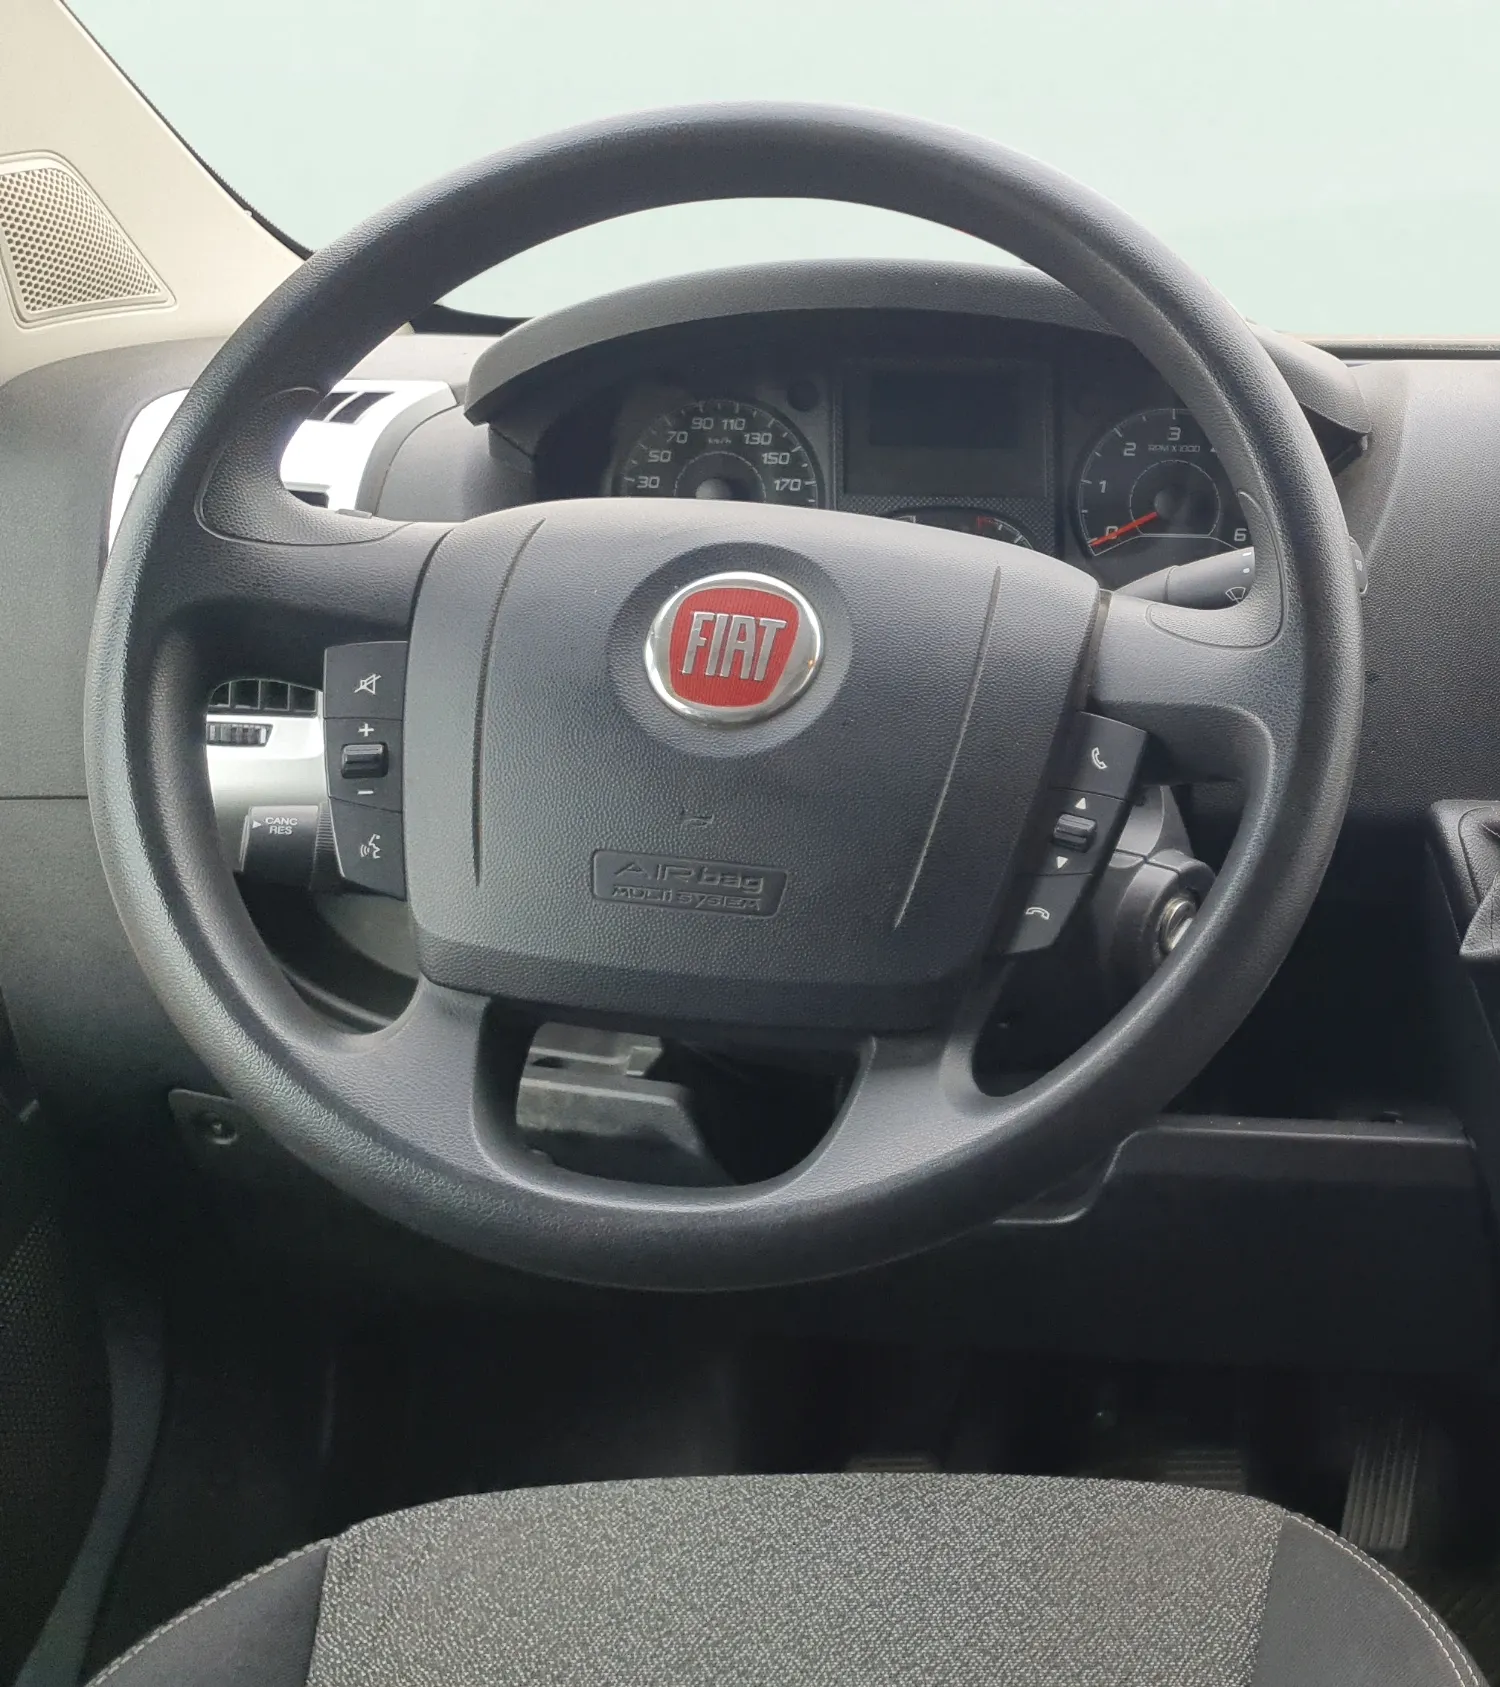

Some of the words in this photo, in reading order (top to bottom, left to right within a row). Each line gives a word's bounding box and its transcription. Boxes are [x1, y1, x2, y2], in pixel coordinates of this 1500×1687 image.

[691, 417, 714, 430] 90
[721, 418, 746, 431] 110
[666, 431, 688, 443] 70
[744, 432, 772, 445] 130
[1167, 426, 1182, 441] 3
[1123, 442, 1137, 456] 2
[648, 450, 672, 462] 50
[761, 452, 790, 465] 150
[637, 476, 660, 489] 30
[773, 479, 801, 491] 170
[1099, 480, 1107, 494] 1
[1234, 528, 1247, 542] 6
[681, 611, 787, 681] FIAT
[265, 817, 298, 826] CANC
[269, 825, 293, 834] RES
